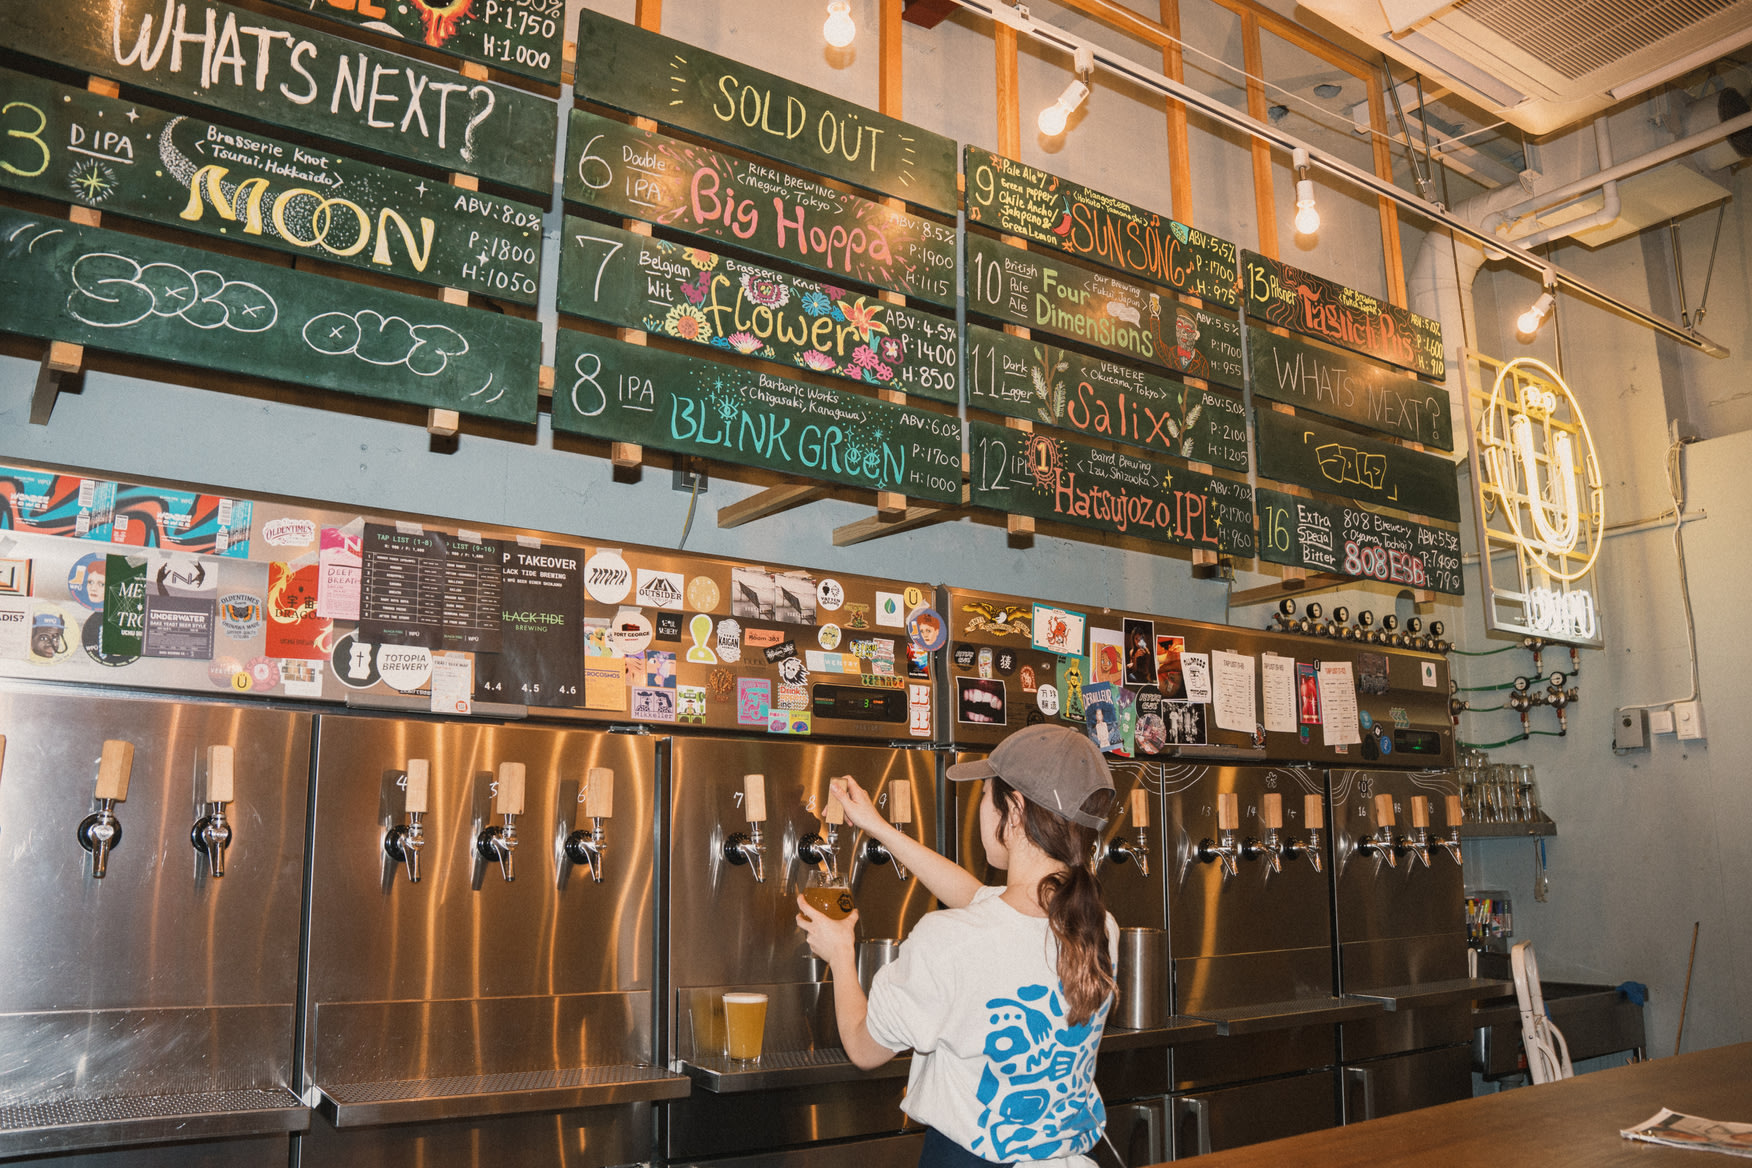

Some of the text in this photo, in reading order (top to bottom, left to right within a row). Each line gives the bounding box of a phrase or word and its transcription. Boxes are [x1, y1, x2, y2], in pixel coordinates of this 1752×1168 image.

[113, 0, 495, 163] WHAT'S NEXT?
[713, 75, 806, 139] SOLD
[0, 102, 50, 177] 3
[207, 125, 328, 169] Brasserie Knot
[579, 134, 613, 189] 6
[622, 145, 666, 171] Double
[1002, 158, 1021, 177] Pale
[1022, 166, 1037, 184] Ale
[626, 175, 661, 201] IPA
[748, 162, 836, 199] RIKRI BREWING
[975, 165, 994, 206] 9
[180, 165, 435, 272] MOON
[691, 167, 893, 273] Big Hoppa
[1001, 216, 1057, 245] Green Lemon
[1041, 217, 1052, 230] &
[1071, 202, 1185, 287] SUN SONG
[575, 235, 624, 302] 7
[639, 250, 691, 278] Belgian
[726, 260, 821, 293] Brasserie Knot
[975, 252, 1002, 304] 10
[1004, 257, 1038, 277] British
[647, 276, 674, 301] Wit
[1010, 277, 1030, 293] Pale
[1043, 267, 1091, 305] Four
[1111, 278, 1140, 298] Brewing
[1247, 263, 1297, 306] 13 Pilsner
[703, 273, 860, 356] flower
[1008, 296, 1028, 312] Ale
[1036, 292, 1153, 358] Dimensions
[971, 343, 999, 399] 11
[1003, 354, 1028, 373] Dark
[1100, 362, 1145, 383] VERTERE
[571, 353, 654, 416] 8 IPA
[759, 373, 840, 404] Barbaric Works
[1001, 381, 1034, 402] Lager
[1068, 382, 1170, 447] Salix
[1368, 384, 1440, 441] NEXT?
[978, 437, 1010, 491] 12
[1091, 449, 1152, 475] Baird Brewing
[1173, 490, 1218, 544] IPL
[1265, 506, 1289, 551] 16
[1297, 504, 1332, 528] Extra
[1343, 508, 1411, 538] 808 Brewery
[1297, 526, 1333, 548] Special
[518, 554, 577, 571] TAKEOVER
[1303, 544, 1336, 566] Bitter
[639, 588, 682, 600] OUTSIDER
[150, 612, 206, 623] UNDERWATER
[515, 624, 548, 633] BREWING
[382, 662, 429, 671] BREWERY
[385, 654, 427, 662] TOTOPIA
[484, 682, 577, 694] 4.4 4.5 4.6
[577, 784, 589, 803] 6
[733, 792, 744, 808] 7
[805, 794, 816, 811] 8
